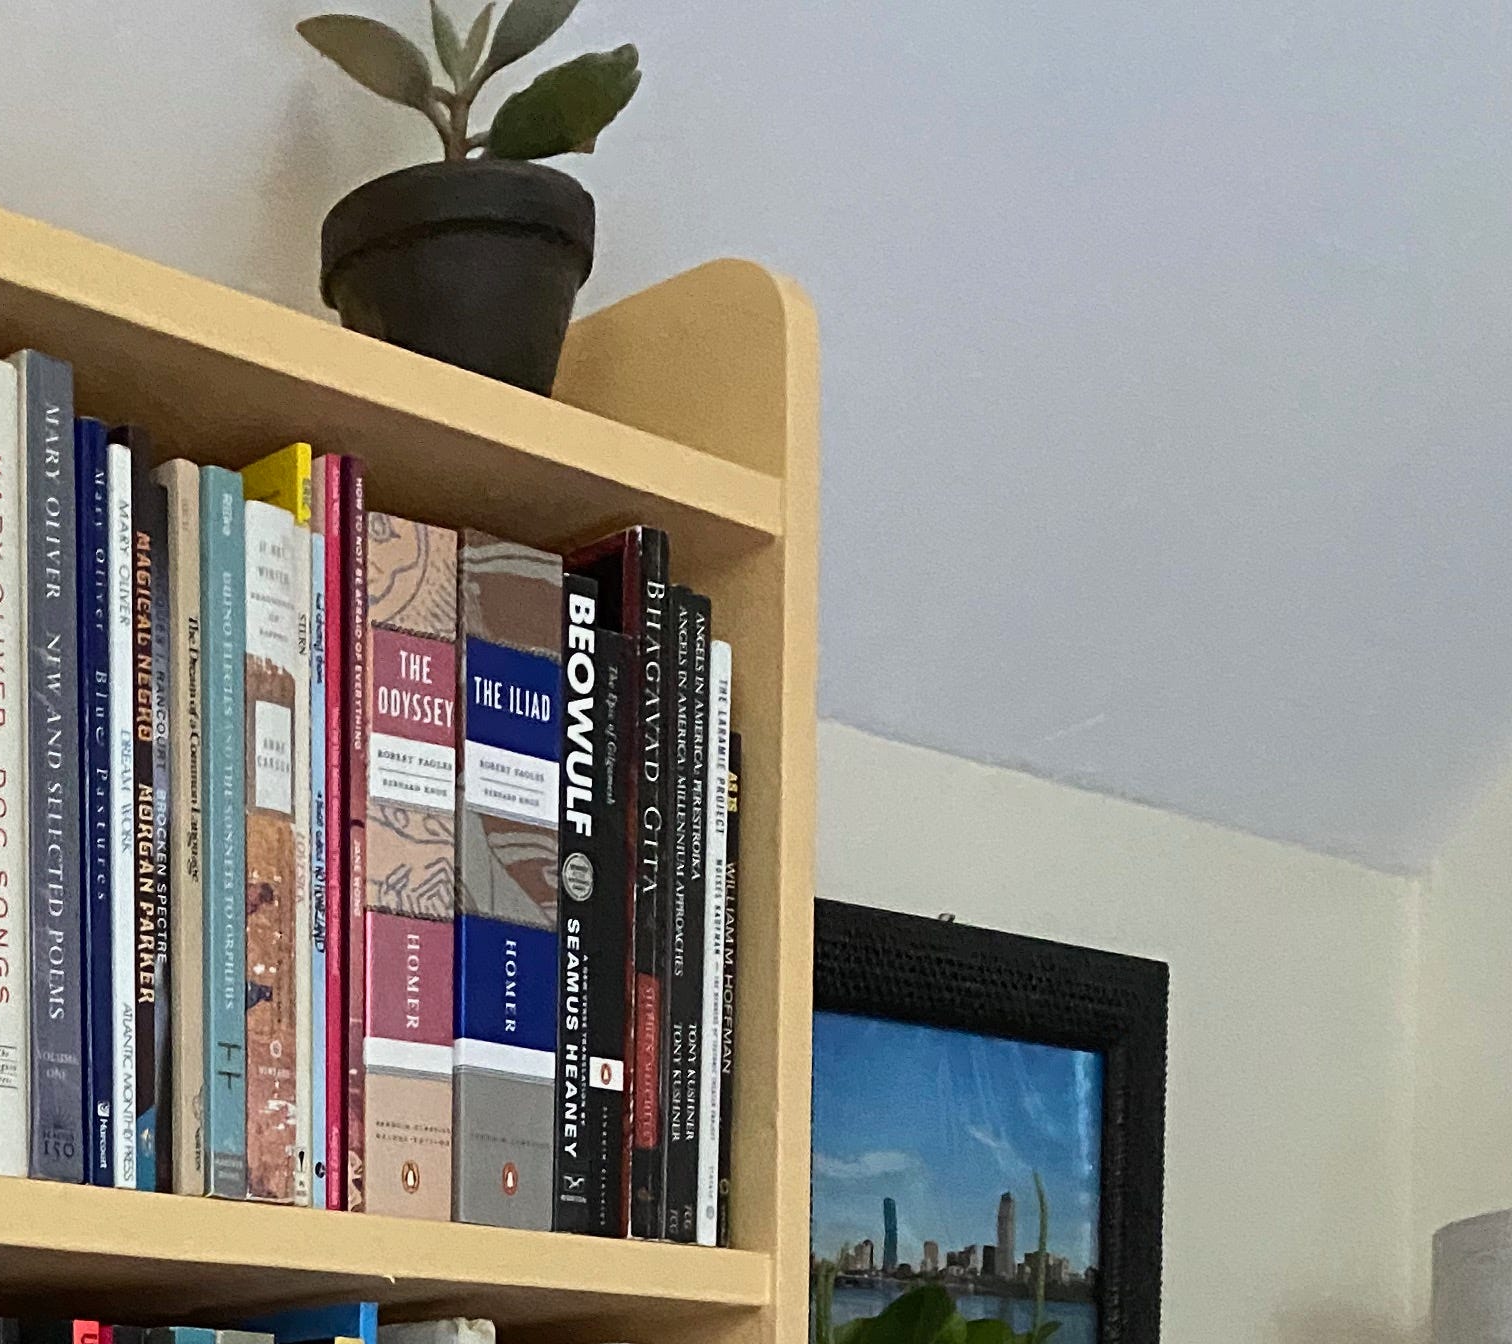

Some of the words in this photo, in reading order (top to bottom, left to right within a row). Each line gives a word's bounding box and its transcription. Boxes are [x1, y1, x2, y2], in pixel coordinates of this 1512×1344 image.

[378, 686, 454, 727] ODYSSEY
[400, 650, 431, 684] THE
[474, 676, 502, 709] THE
[509, 685, 550, 721] ILIAD
[566, 594, 595, 836] BEOWULF
[643, 580, 665, 782] BHAGAVAD
[137, 784, 154, 894] MORGAN
[642, 807, 662, 894] GITA
[138, 902, 155, 1004] PARKER
[406, 934, 420, 1029] HOMER
[504, 939, 516, 1033] HOMER
[565, 919, 580, 1029] SEAMUS
[564, 1045, 578, 1157] HEANEY
